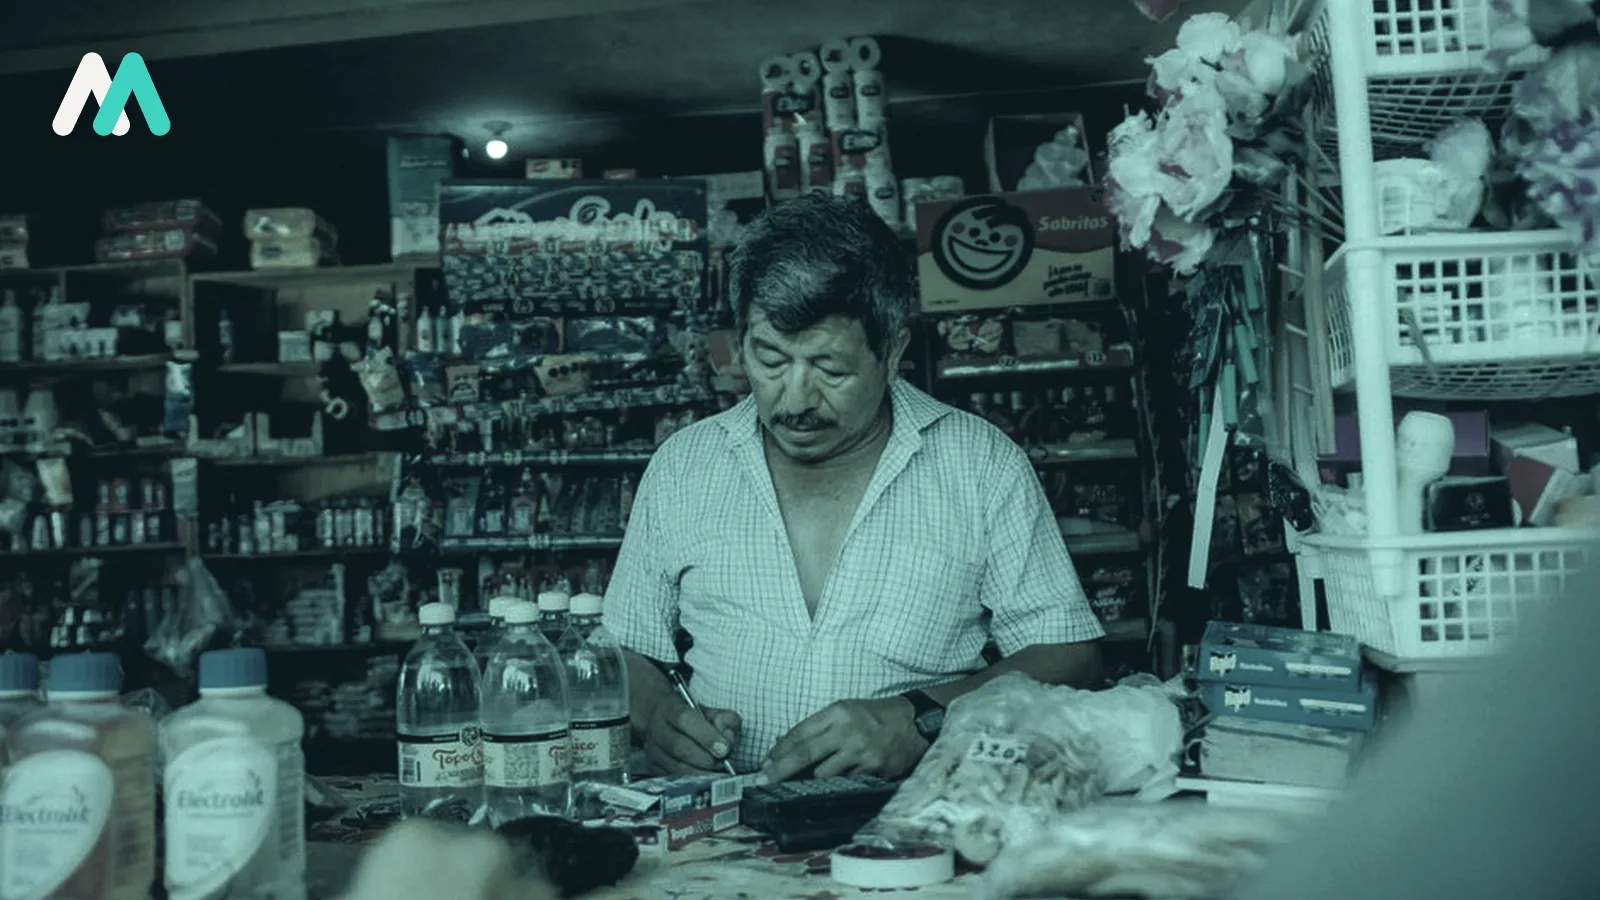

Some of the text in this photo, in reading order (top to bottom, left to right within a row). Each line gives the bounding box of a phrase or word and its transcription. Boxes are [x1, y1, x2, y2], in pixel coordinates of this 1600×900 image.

[1038, 215, 1109, 232] Sabritas
[432, 748, 470, 769] Topo
[178, 788, 264, 809] Electrolit
